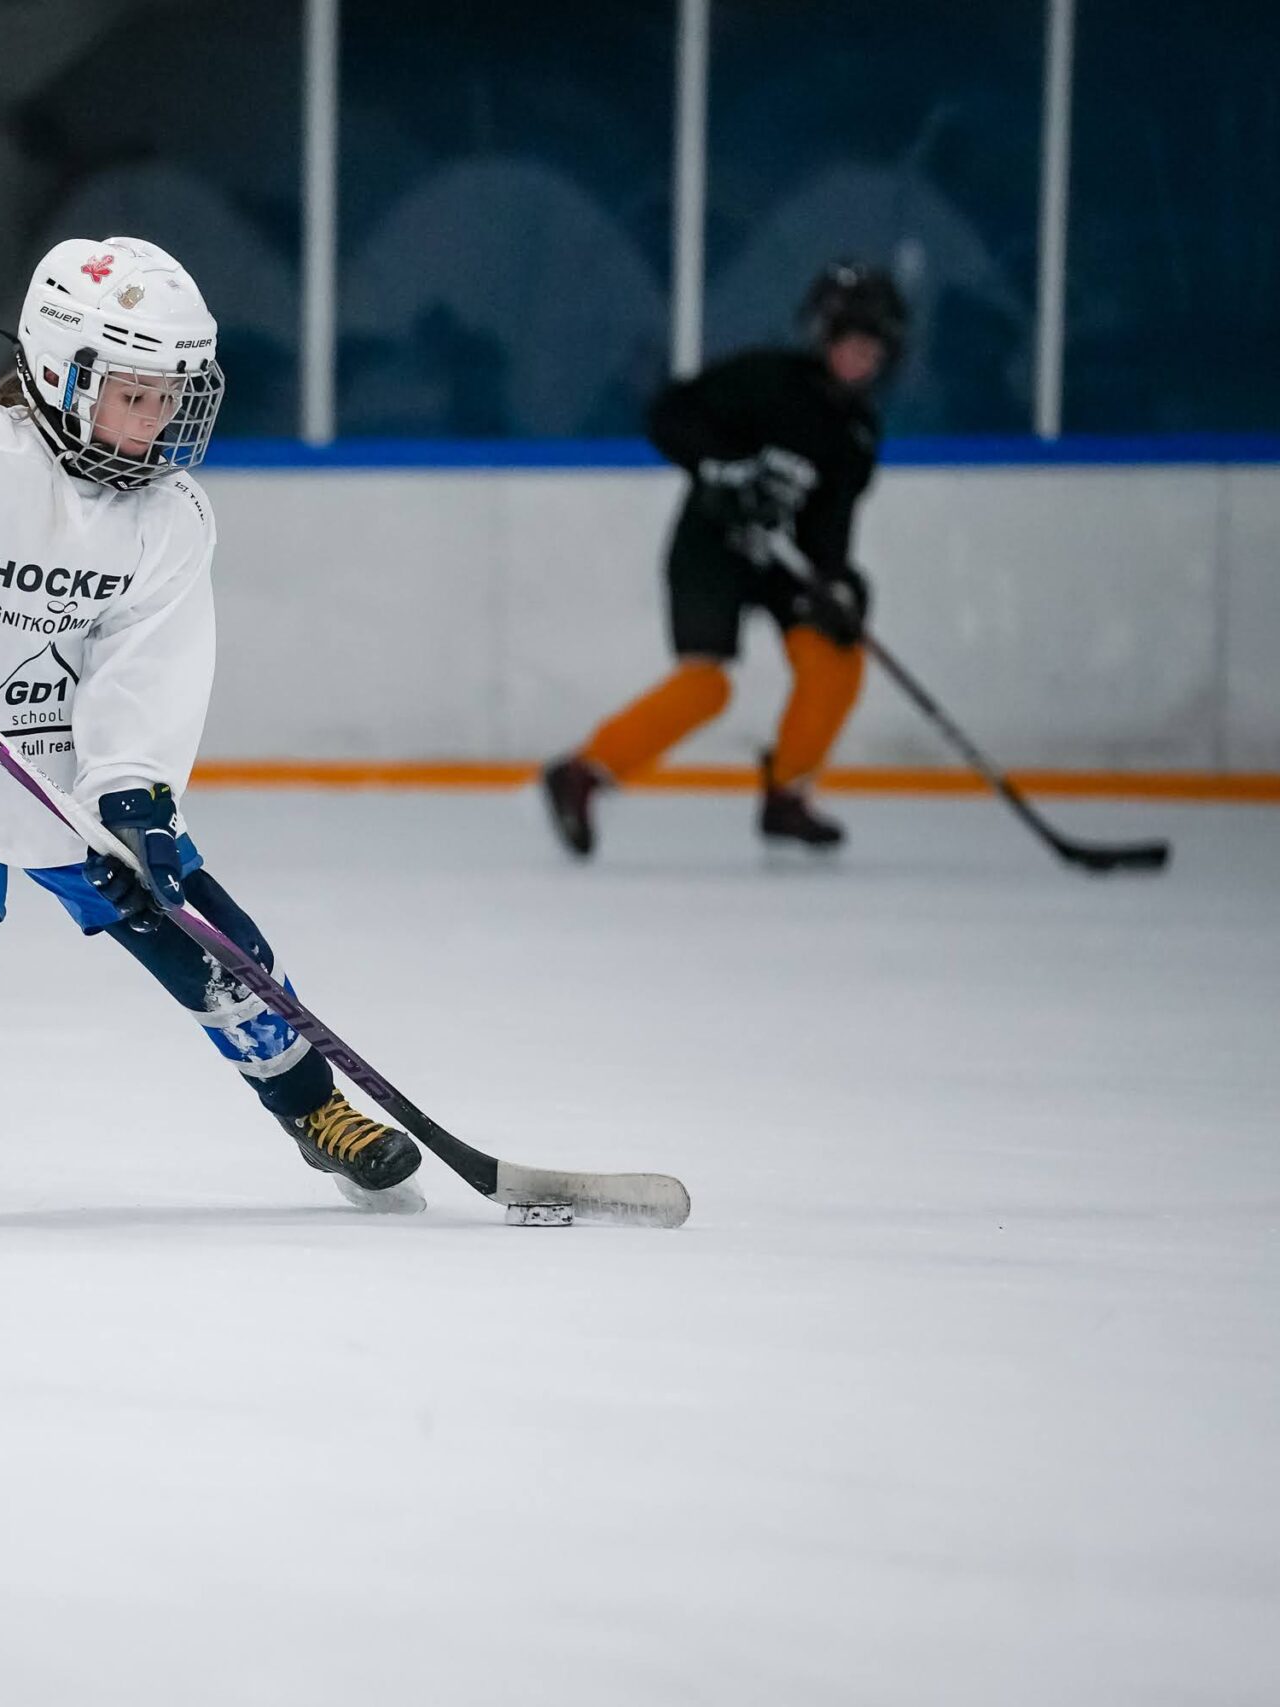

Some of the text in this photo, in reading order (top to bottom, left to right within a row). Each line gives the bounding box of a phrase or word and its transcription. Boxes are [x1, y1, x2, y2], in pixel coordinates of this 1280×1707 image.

[39, 305, 81, 325] BAUER
[174, 338, 212, 349] BAUER
[57, 614, 98, 634] DMI
[4, 676, 68, 706] GD1
[12, 708, 64, 726] school
[21, 739, 44, 757] full
